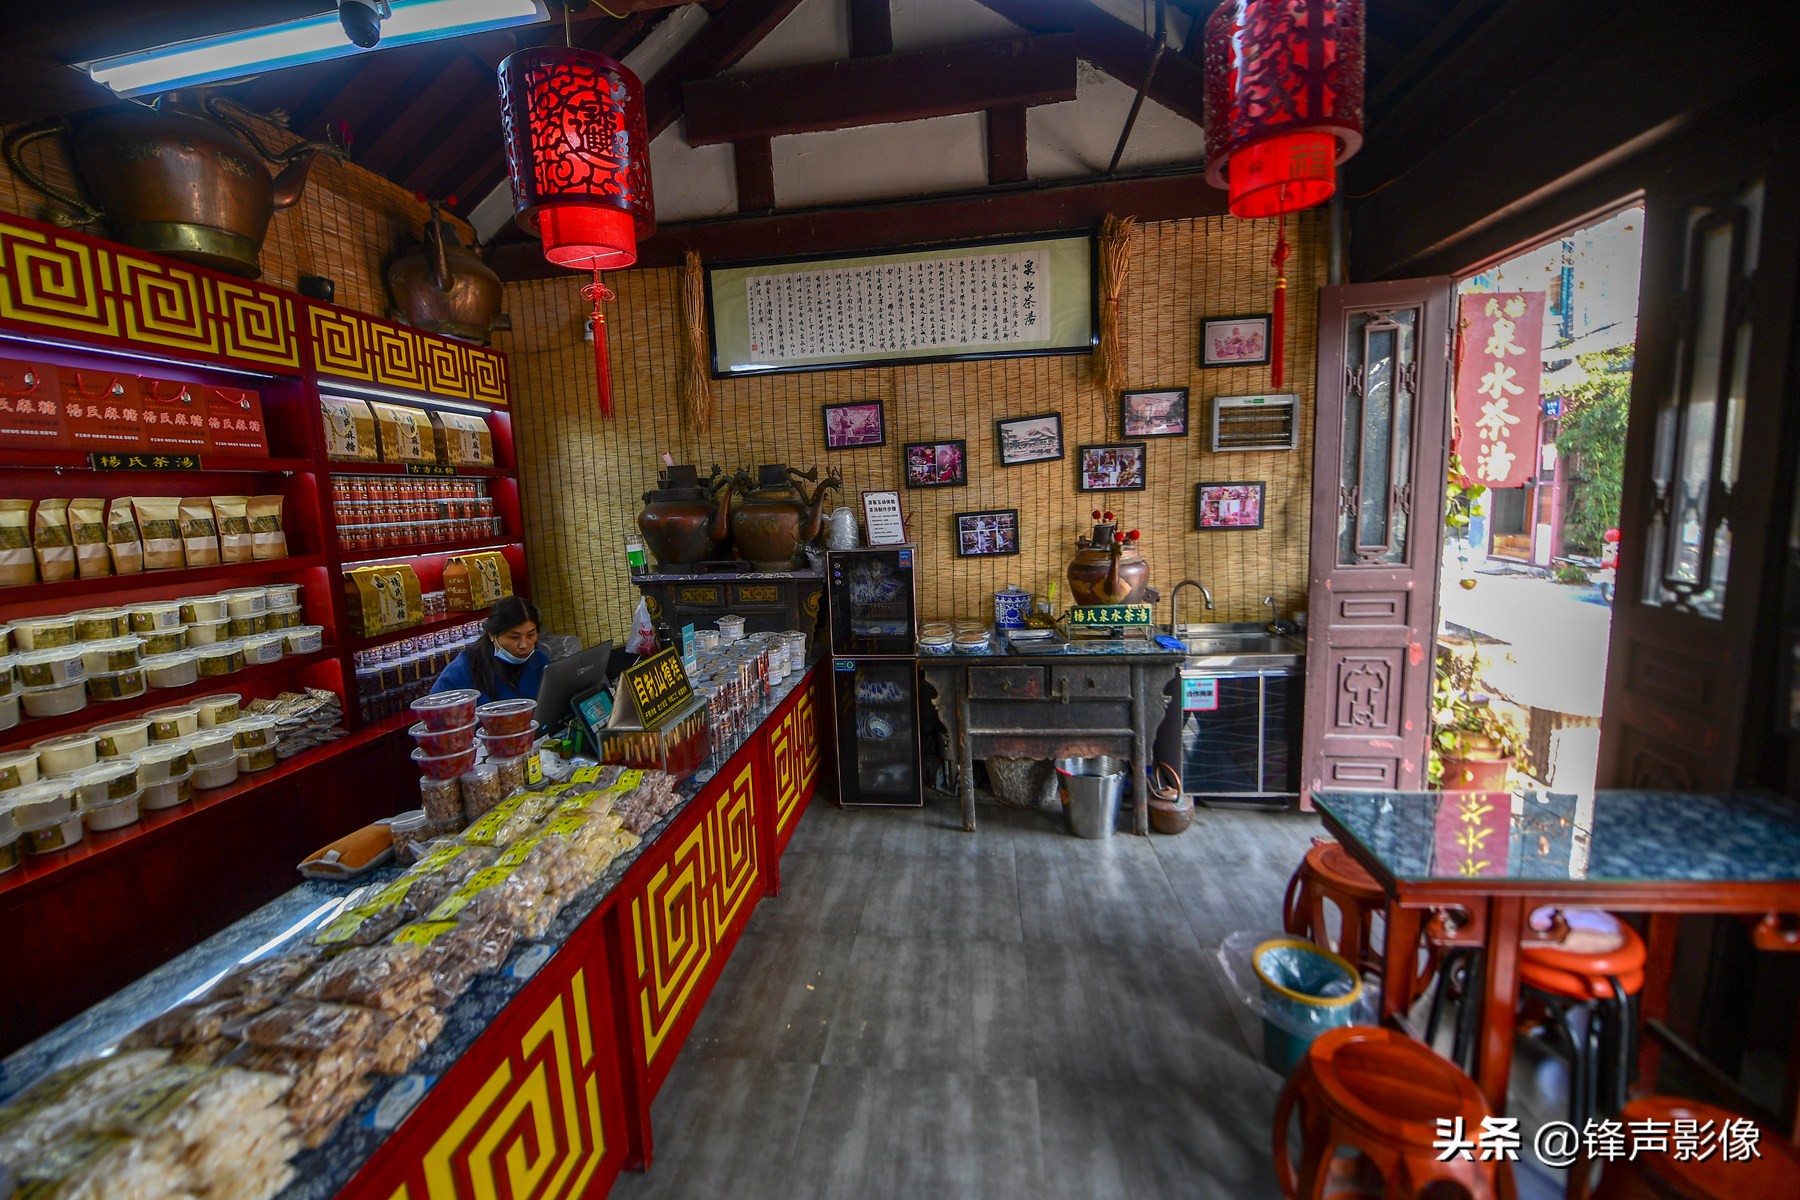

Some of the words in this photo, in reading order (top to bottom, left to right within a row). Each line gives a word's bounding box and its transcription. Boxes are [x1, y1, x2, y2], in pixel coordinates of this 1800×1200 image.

[1290, 142, 1327, 179] 福
[1022, 259, 1037, 326] 泉水茶湯
[100, 455, 194, 469] 楊氏茶湯
[1073, 608, 1148, 623] 楊氏泉水茶湯
